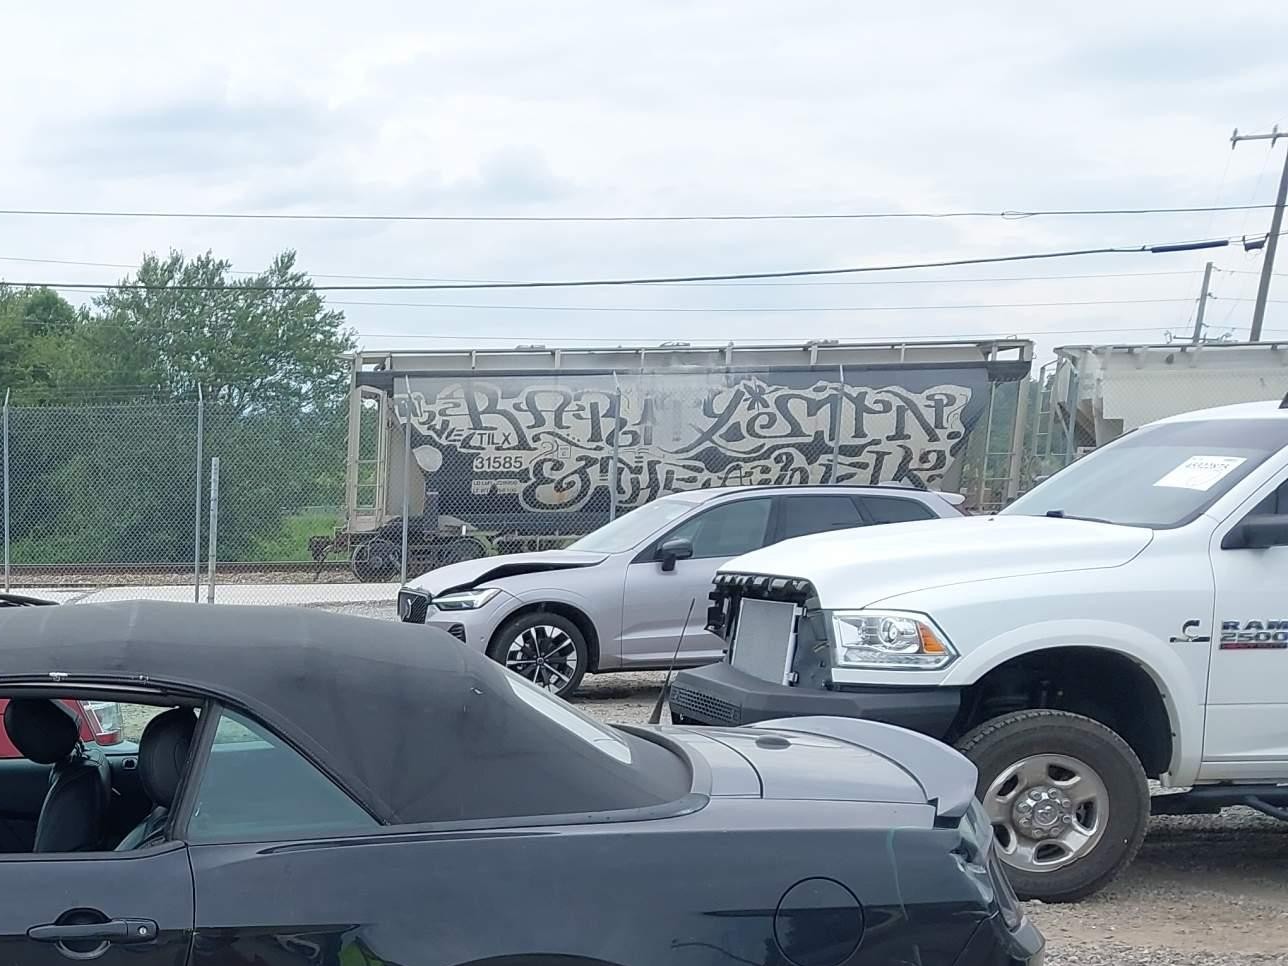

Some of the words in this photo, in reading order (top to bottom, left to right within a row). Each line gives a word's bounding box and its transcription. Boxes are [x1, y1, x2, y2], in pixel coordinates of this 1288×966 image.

[477, 432, 512, 446] TILX
[474, 456, 523, 470] 31585
[1221, 620, 1288, 630] RAM
[1220, 631, 1288, 641] 2500
